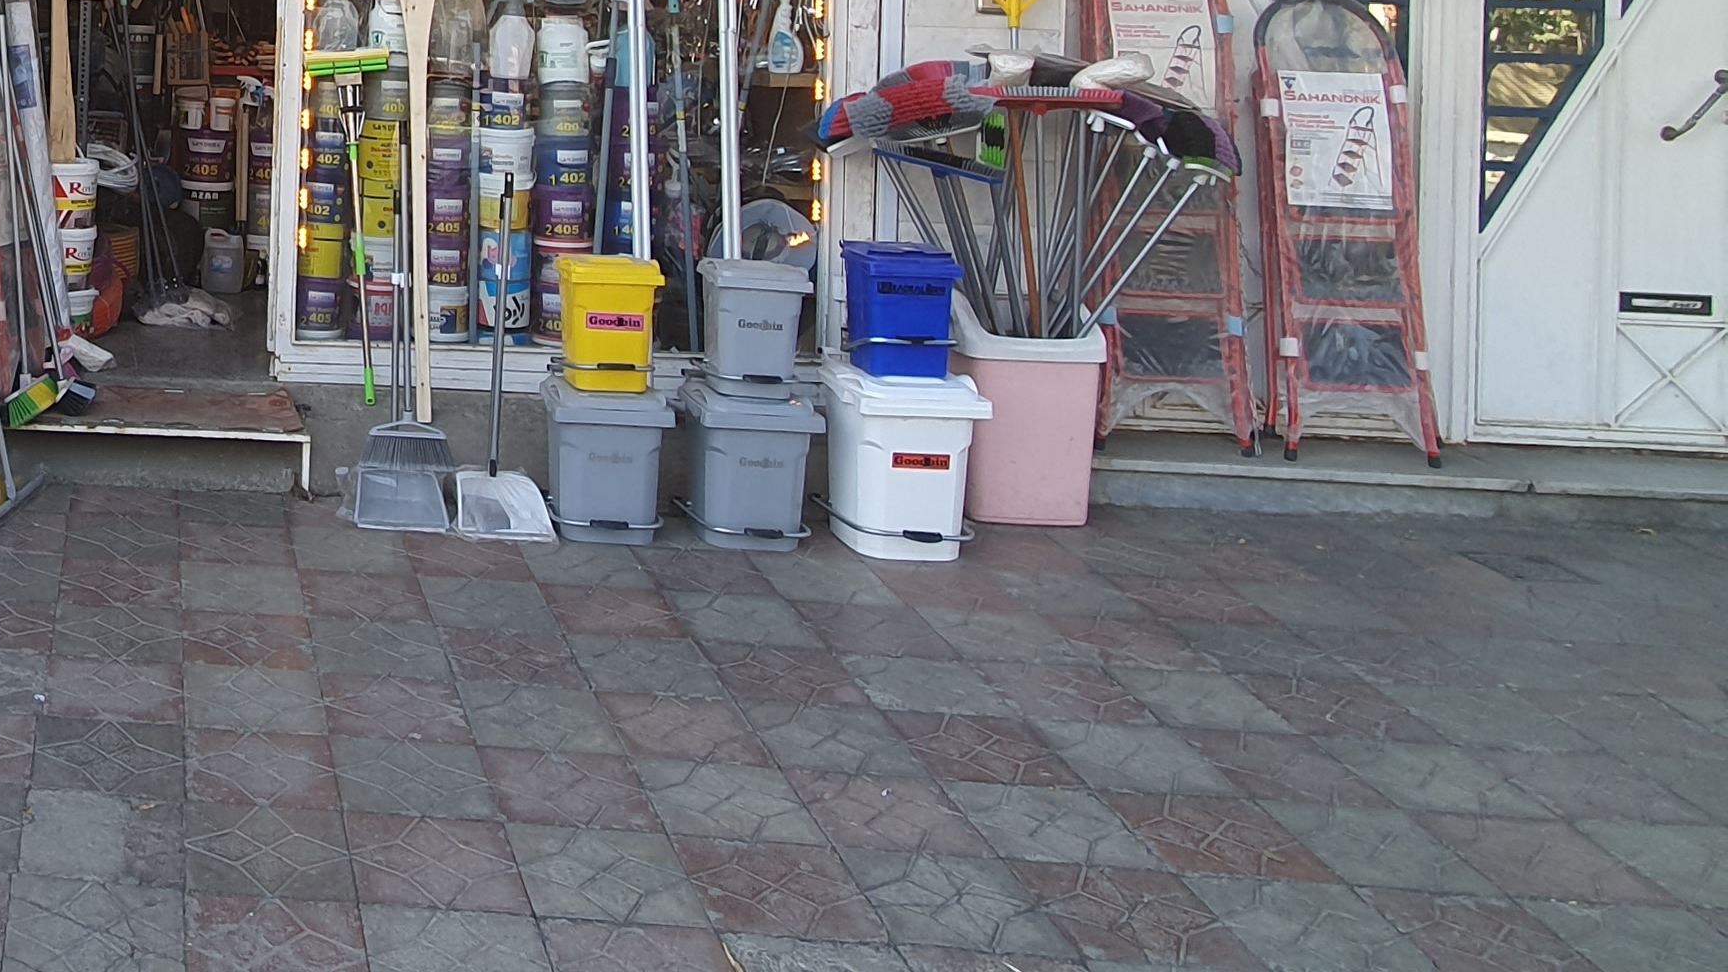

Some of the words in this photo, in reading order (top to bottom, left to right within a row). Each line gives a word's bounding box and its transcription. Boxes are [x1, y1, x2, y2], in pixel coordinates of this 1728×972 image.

[1112, 2, 1202, 13] SAHANDNIK
[1284, 90, 1381, 104] SAHANDNIK
[493, 114, 520, 126] 402
[316, 153, 341, 165] 402
[192, 164, 219, 176] 405
[256, 168, 272, 180] 40
[560, 172, 586, 184] 402
[436, 222, 460, 233] 405
[554, 224, 580, 236] 405
[433, 272, 457, 284] 405
[308, 312, 332, 324] 405
